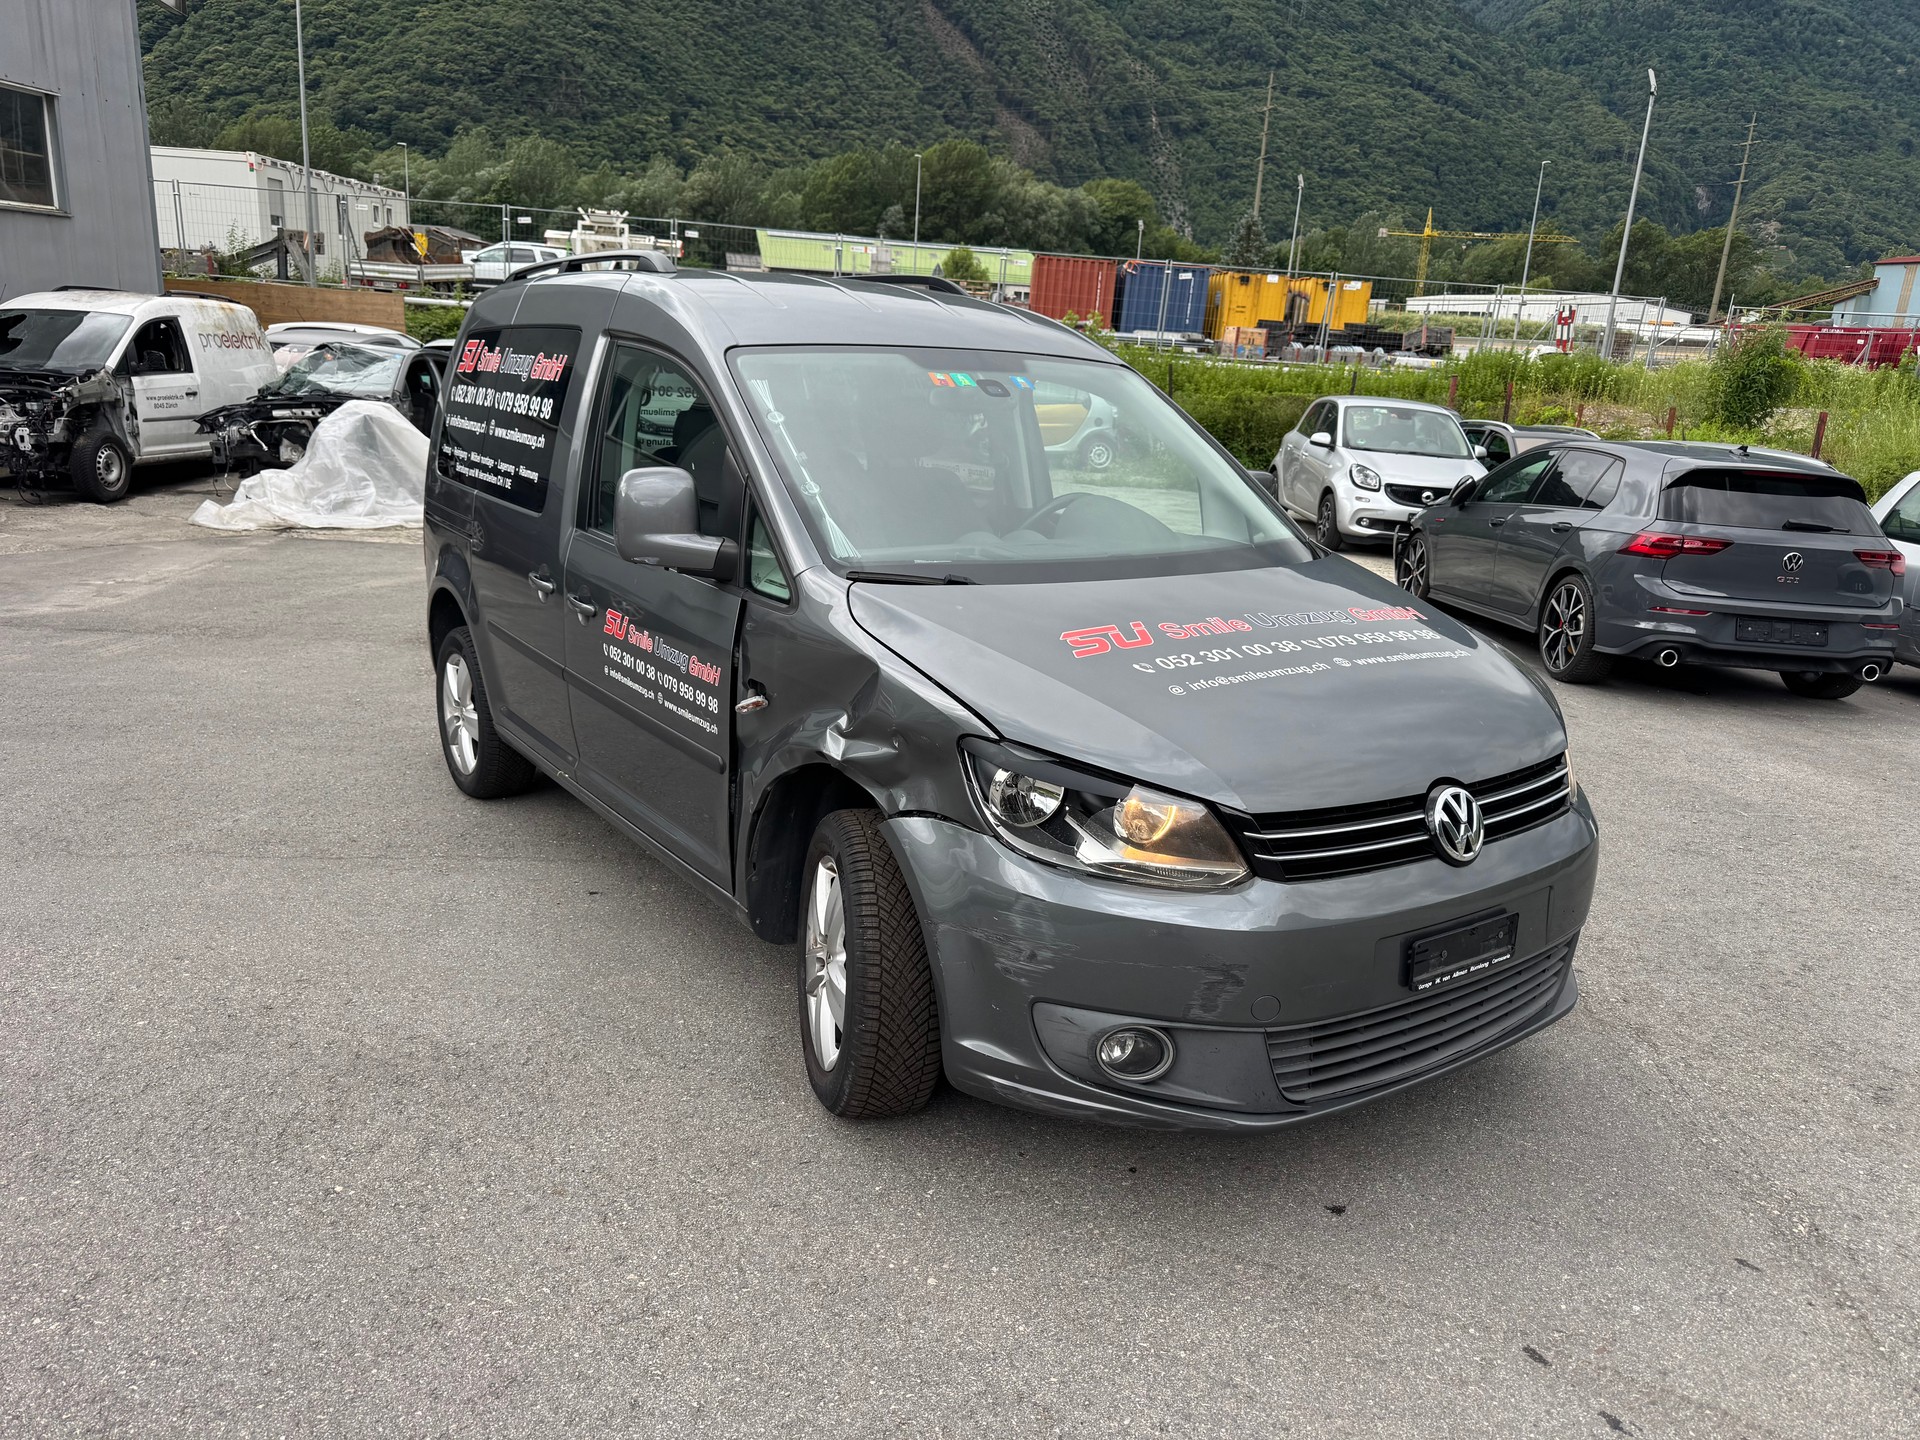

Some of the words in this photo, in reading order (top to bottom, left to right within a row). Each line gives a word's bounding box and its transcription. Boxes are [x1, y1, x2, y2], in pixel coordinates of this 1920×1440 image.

[198, 332, 266, 353] proelektrik
[456, 339, 486, 373] SU
[477, 345, 502, 373] Smile
[499, 347, 536, 382] Umzug
[530, 352, 568, 382] GmbH
[145, 392, 185, 402] www.proelektrik.ch
[164, 401, 179, 409] Zürich
[455, 384, 468, 403] 052
[465, 385, 478, 404] 301
[476, 387, 486, 406] 00
[500, 391, 514, 412] 079
[513, 393, 531, 416] 958
[529, 396, 542, 418] 99
[540, 398, 553, 420] 98
[494, 427, 545, 450] www.smileumzug.ch
[1777, 576, 1800, 584] GTI
[603, 608, 629, 640] SU
[627, 624, 654, 653] Smile
[653, 636, 689, 674] Umzug
[688, 655, 722, 687] GmbH
[1059, 620, 1155, 659] SU
[1157, 616, 1253, 640] Smile
[1243, 609, 1357, 629] Umzug
[1347, 606, 1429, 622] GmbH
[1154, 653, 1204, 670] 052
[1199, 646, 1244, 664] 301
[1241, 643, 1273, 657] 00
[1270, 638, 1303, 653] 38
[1317, 634, 1357, 649] 079
[1353, 631, 1394, 645] 958
[1388, 629, 1418, 641] 99
[1412, 628, 1442, 640] 98
[609, 645, 622, 663] 052
[622, 652, 635, 670] 301
[635, 659, 645, 676] 00
[646, 664, 656, 681] 38
[663, 677, 678, 693] 079
[679, 681, 694, 702] 958
[695, 690, 706, 708] 99
[708, 696, 719, 714] 98
[1185, 661, 1332, 692] info@smileumzug.ch
[1352, 648, 1472, 666] www.smileumzug.ch
[609, 667, 655, 701] info@smileumzug.ch
[664, 699, 719, 736] www.smileumzug.ch
[1434, 786, 1484, 862] VW
